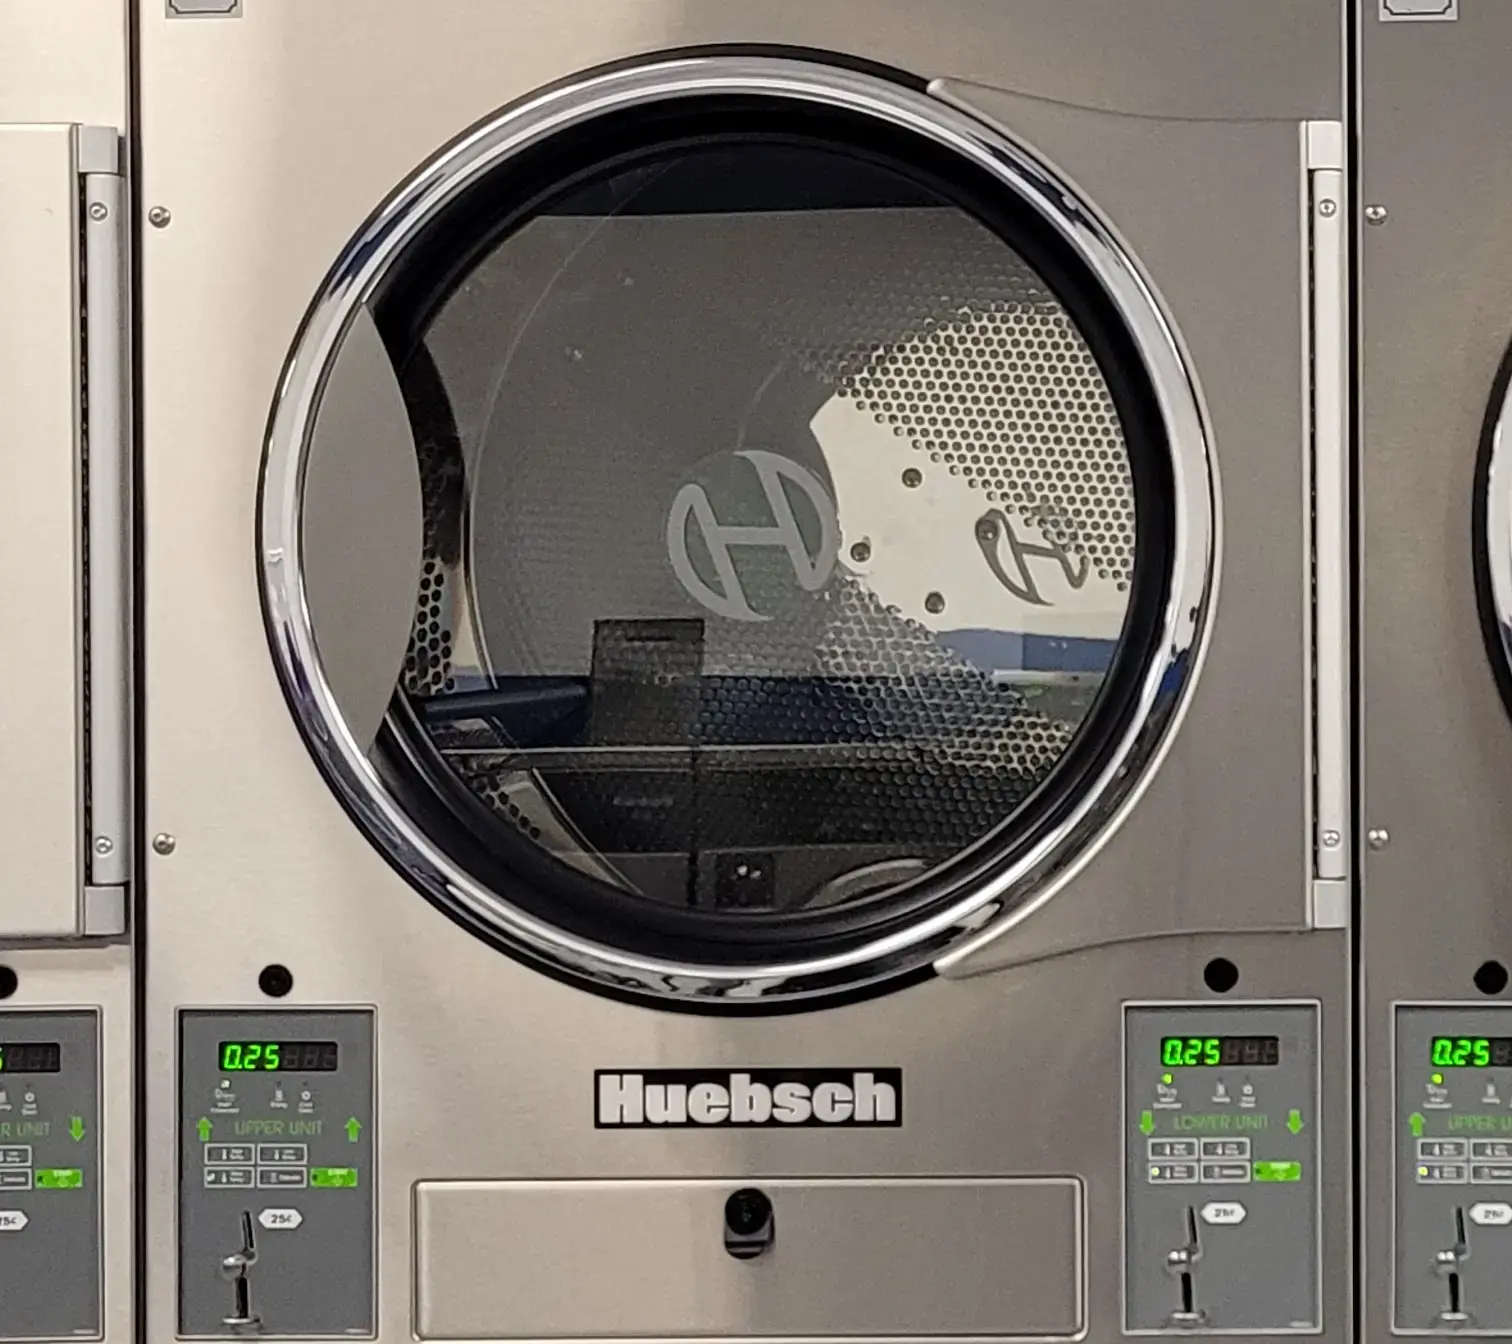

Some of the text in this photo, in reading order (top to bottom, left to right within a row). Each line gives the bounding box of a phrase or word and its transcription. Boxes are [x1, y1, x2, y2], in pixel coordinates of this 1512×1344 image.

[223, 1044, 280, 1069] 0.25
[1163, 1038, 1220, 1066] 0.25
[1432, 1038, 1490, 1066] 0.25
[599, 1072, 896, 1123] Huebsch
[234, 1120, 323, 1136] UPPER UNIT
[1173, 1114, 1231, 1131] LOWER
